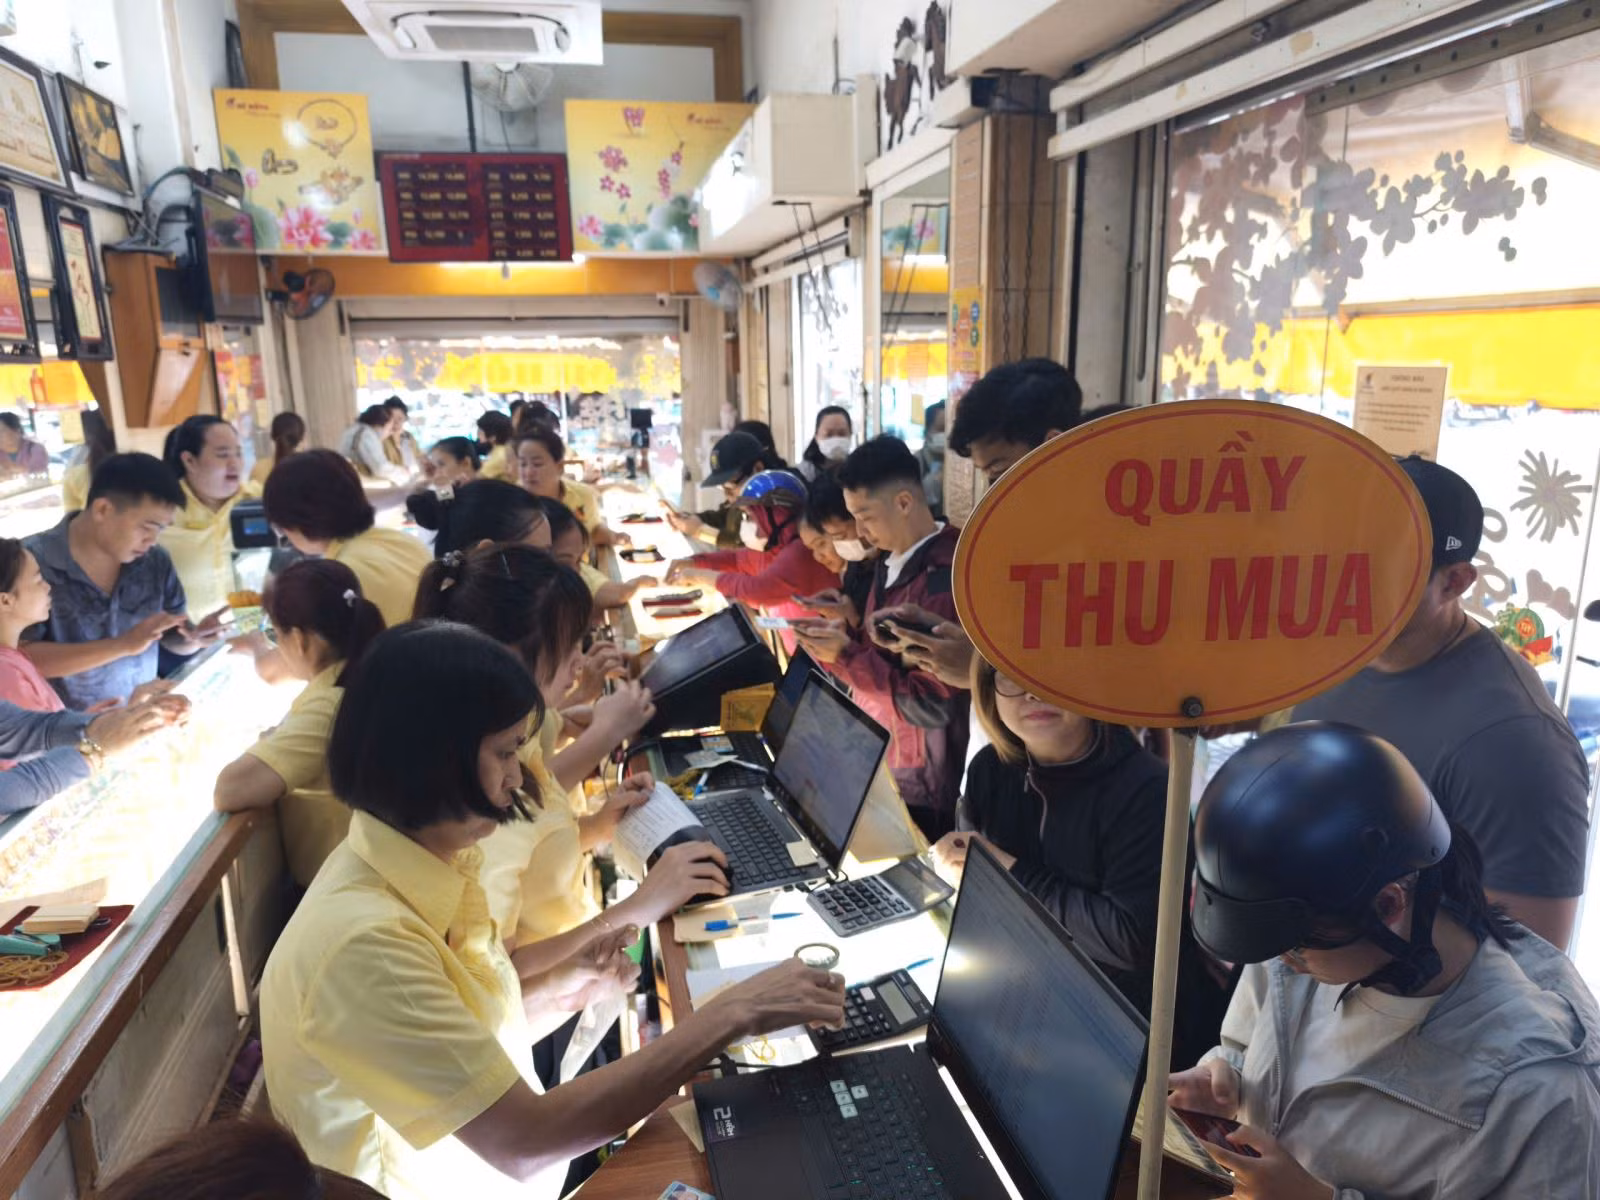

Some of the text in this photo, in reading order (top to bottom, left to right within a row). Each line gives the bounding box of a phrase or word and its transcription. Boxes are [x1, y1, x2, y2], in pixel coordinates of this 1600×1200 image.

[1104, 430, 1307, 527] QUẦY
[1009, 552, 1374, 650] THU MUA
